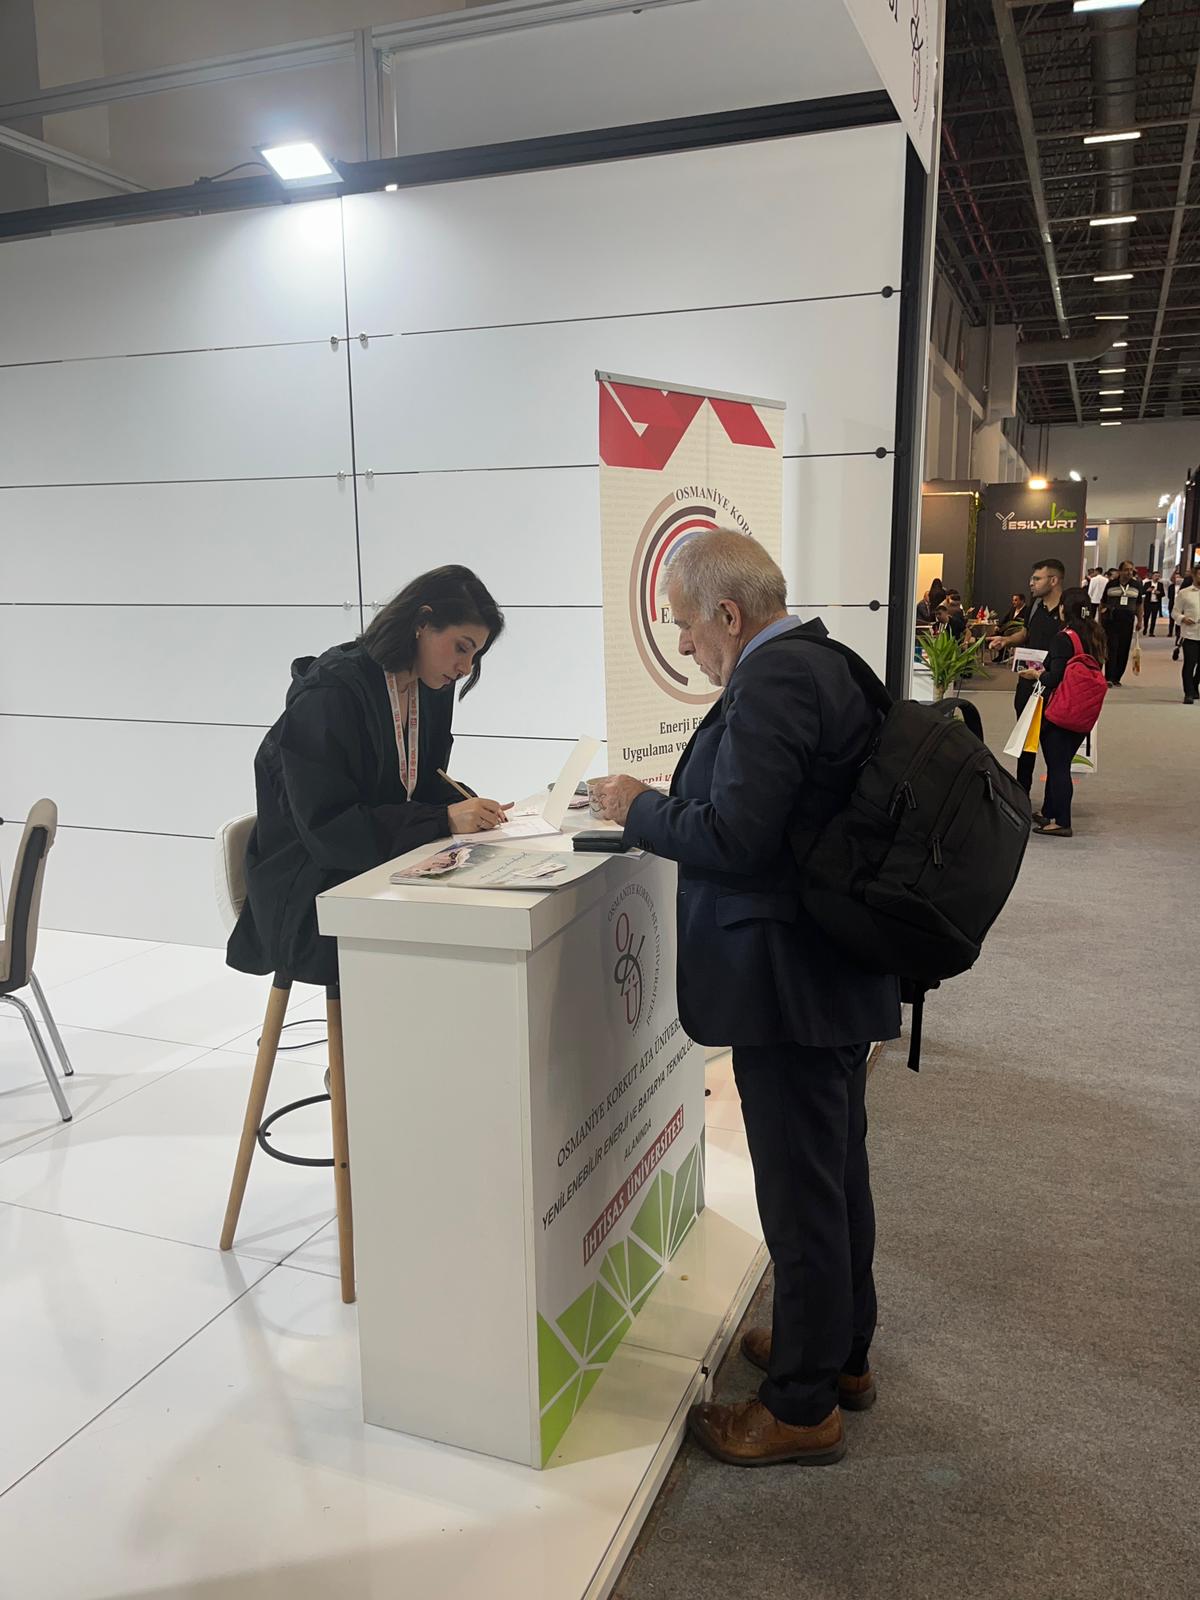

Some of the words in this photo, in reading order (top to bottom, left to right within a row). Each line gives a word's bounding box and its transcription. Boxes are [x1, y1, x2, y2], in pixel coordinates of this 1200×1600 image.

[675, 486, 730, 511] OSMANİYE
[730, 506, 753, 536] KOR
[622, 743, 674, 763] Uygulama
[676, 741, 687, 752] ve
[660, 718, 690, 734] Enerji
[557, 1102, 605, 1167] OSMANİYE
[606, 1063, 639, 1112] KORKUT
[639, 1047, 654, 1074] ATA
[654, 1018, 681, 1055] ÜNİVER
[542, 1145, 603, 1231] YENİLENEBİLİR
[603, 1110, 629, 1155] ENERJİ
[629, 1105, 638, 1123] VE
[638, 1069, 666, 1113] BATARYA
[584, 1192, 625, 1263] İHTİSAS
[626, 1108, 684, 1199] ÜNİVERSİTESİ
